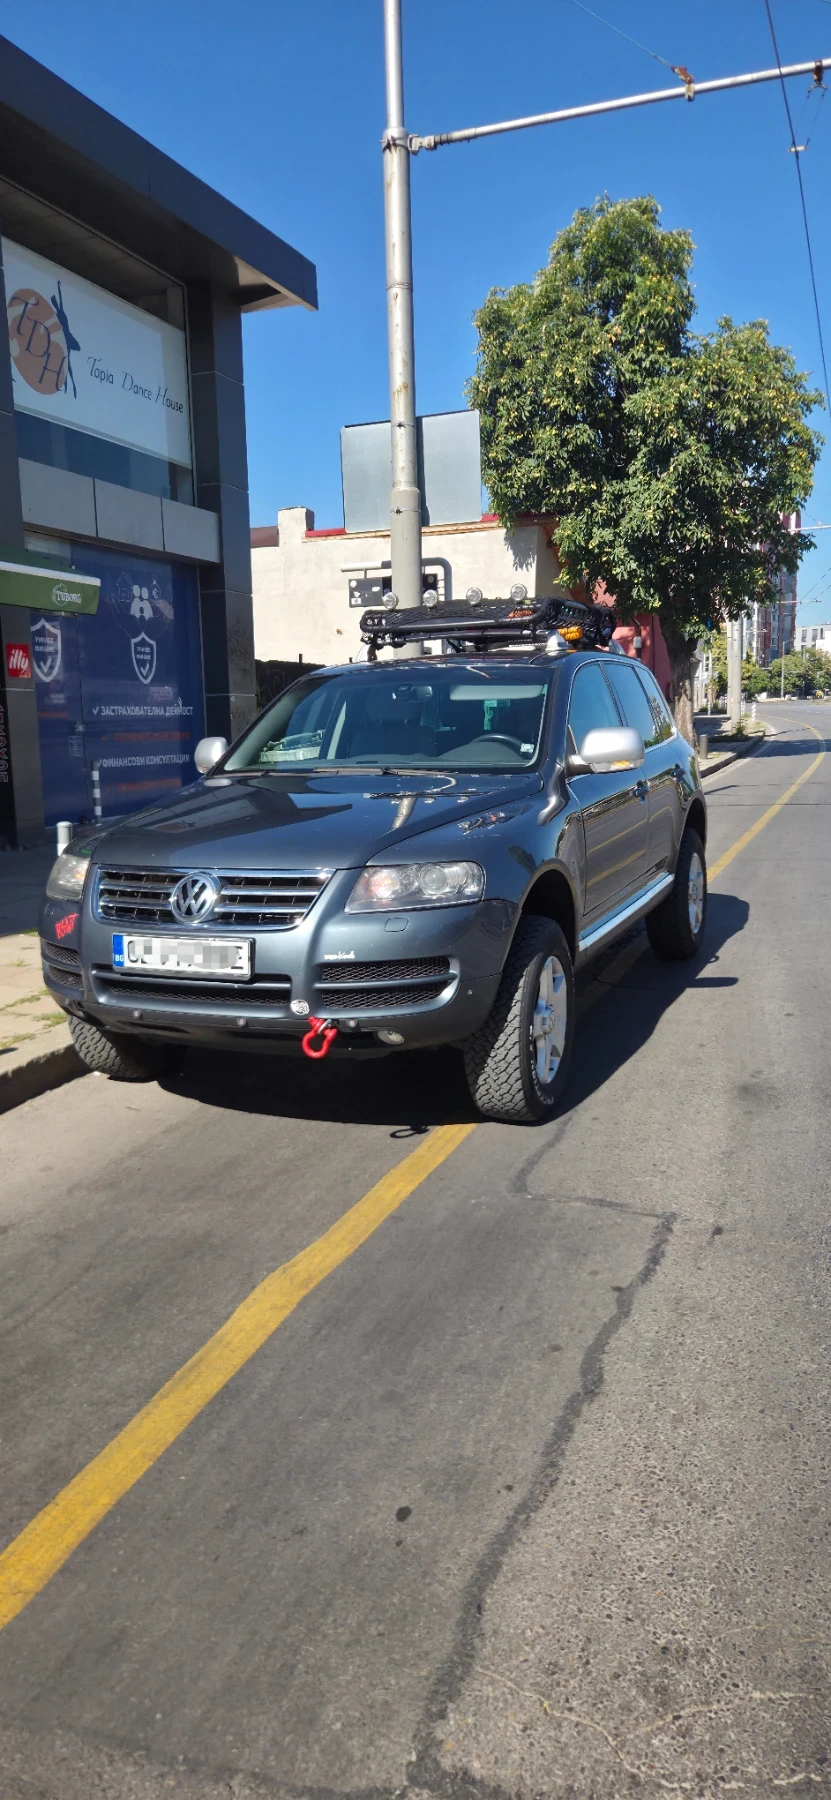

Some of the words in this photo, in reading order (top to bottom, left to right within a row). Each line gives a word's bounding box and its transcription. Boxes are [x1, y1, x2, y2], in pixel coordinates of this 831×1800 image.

[121, 370, 152, 401] Dance
[155, 386, 184, 413] House
[56, 591, 81, 604] TUBORG
[9, 649, 29, 675] illy
[101, 705, 165, 716] ЗАСТРАХОВАТЕЛНА
[165, 704, 193, 717] ДЕЙНОСТ
[102, 756, 145, 768] ФИНАНСОВИ
[146, 754, 190, 766] КОНСУЛТАЦИИ
[115, 954, 124, 962] BG
